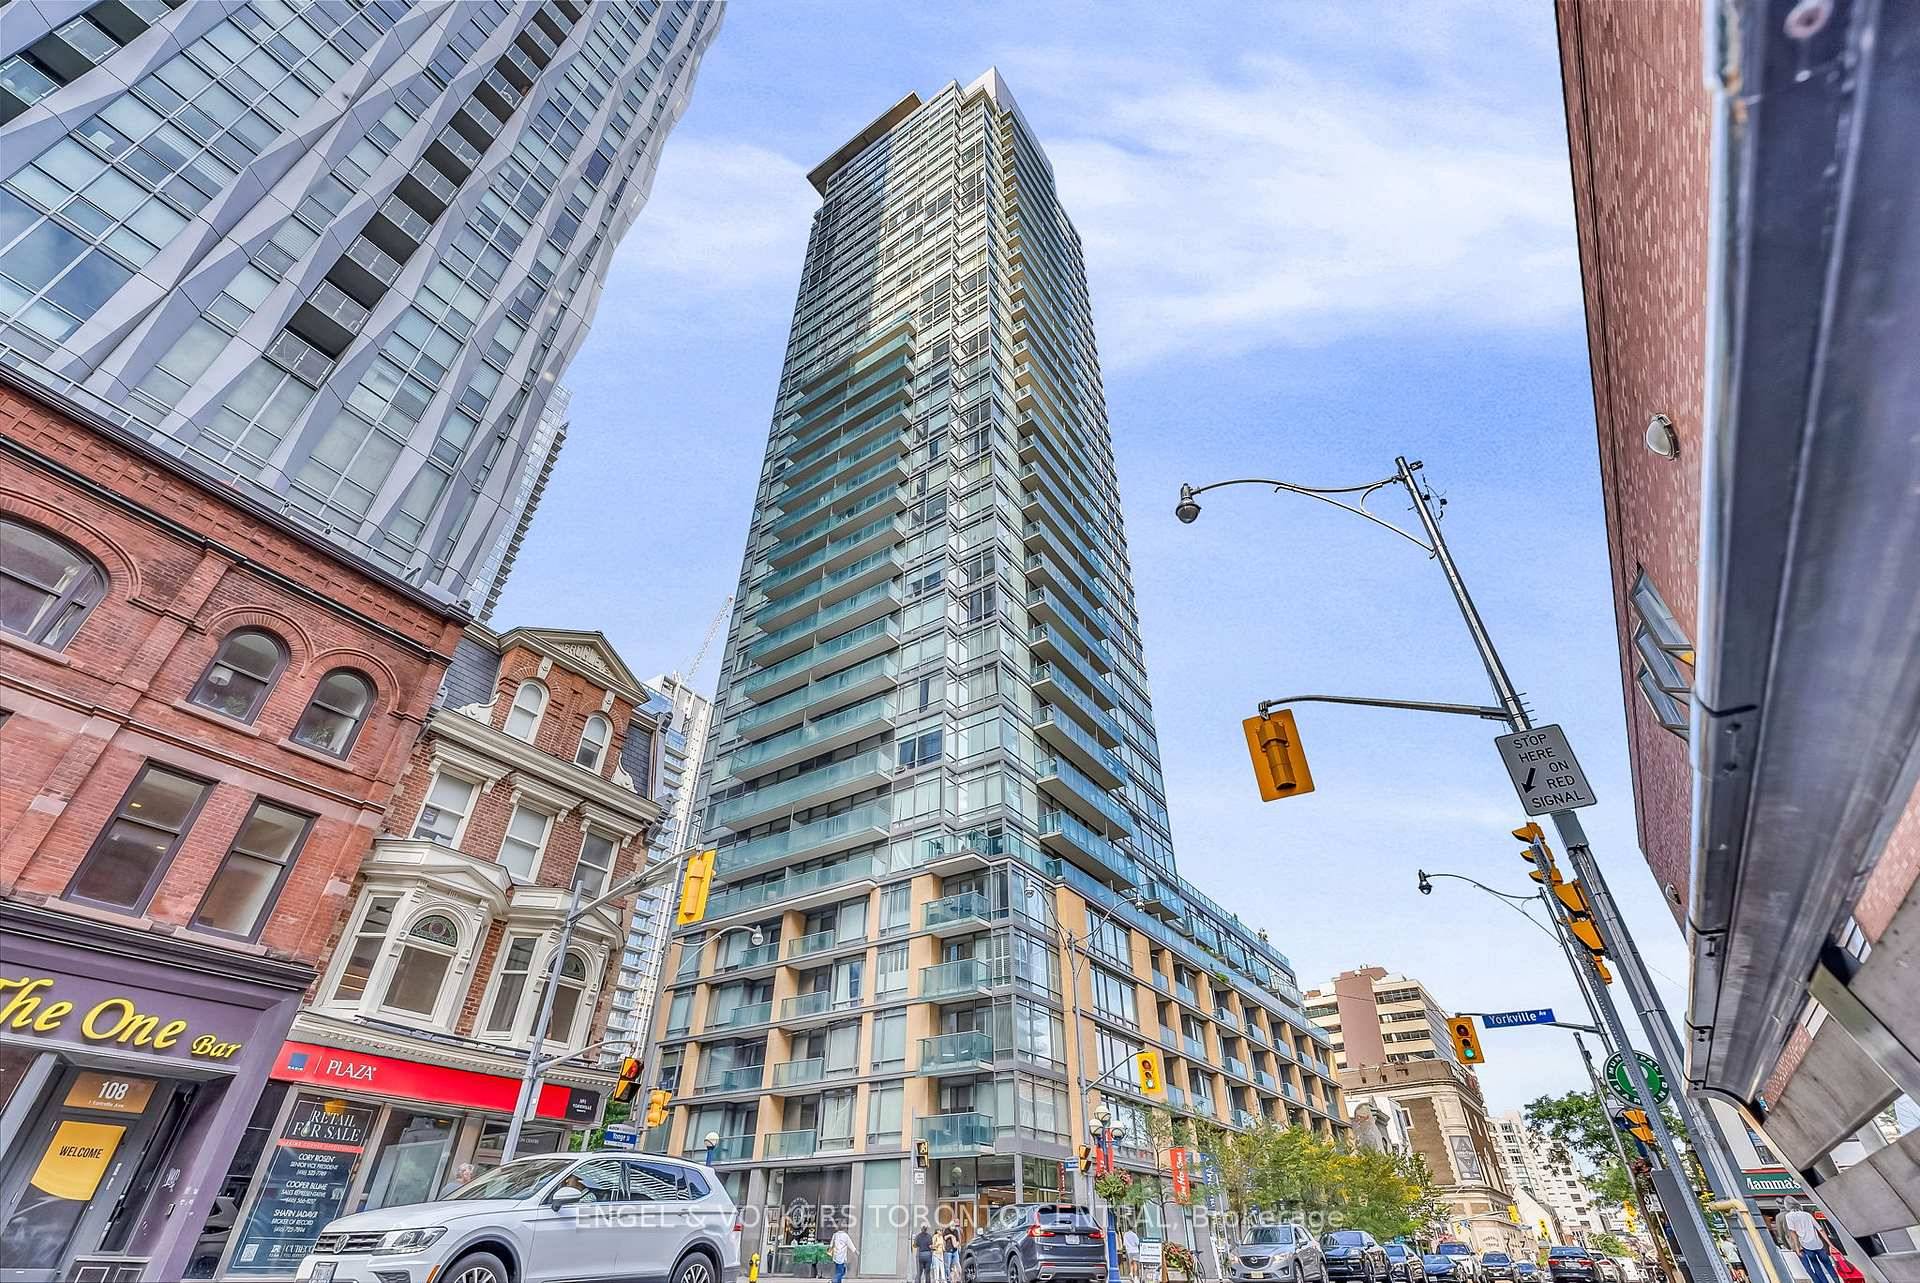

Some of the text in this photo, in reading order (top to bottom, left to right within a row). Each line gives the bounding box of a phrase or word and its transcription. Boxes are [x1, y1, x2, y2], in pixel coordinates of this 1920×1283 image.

[1513, 734, 1546, 749] STOP
[1519, 747, 1556, 763] HERE
[1549, 760, 1569, 772] ON
[1546, 775, 1575, 789] RED
[1532, 790, 1585, 808] SIGNAL
[0, 977, 242, 1060] The One Bar
[1489, 1012, 1537, 1025] Yorkville
[326, 1059, 373, 1081] PLAZA
[1608, 1053, 1660, 1074] MUNIPAL
[98, 1080, 129, 1100] 108
[1614, 1082, 1668, 1104] PARING
[311, 1110, 356, 1127] RETAIL
[324, 1125, 361, 1142] SALE
[59, 1146, 104, 1159] WELCOME
